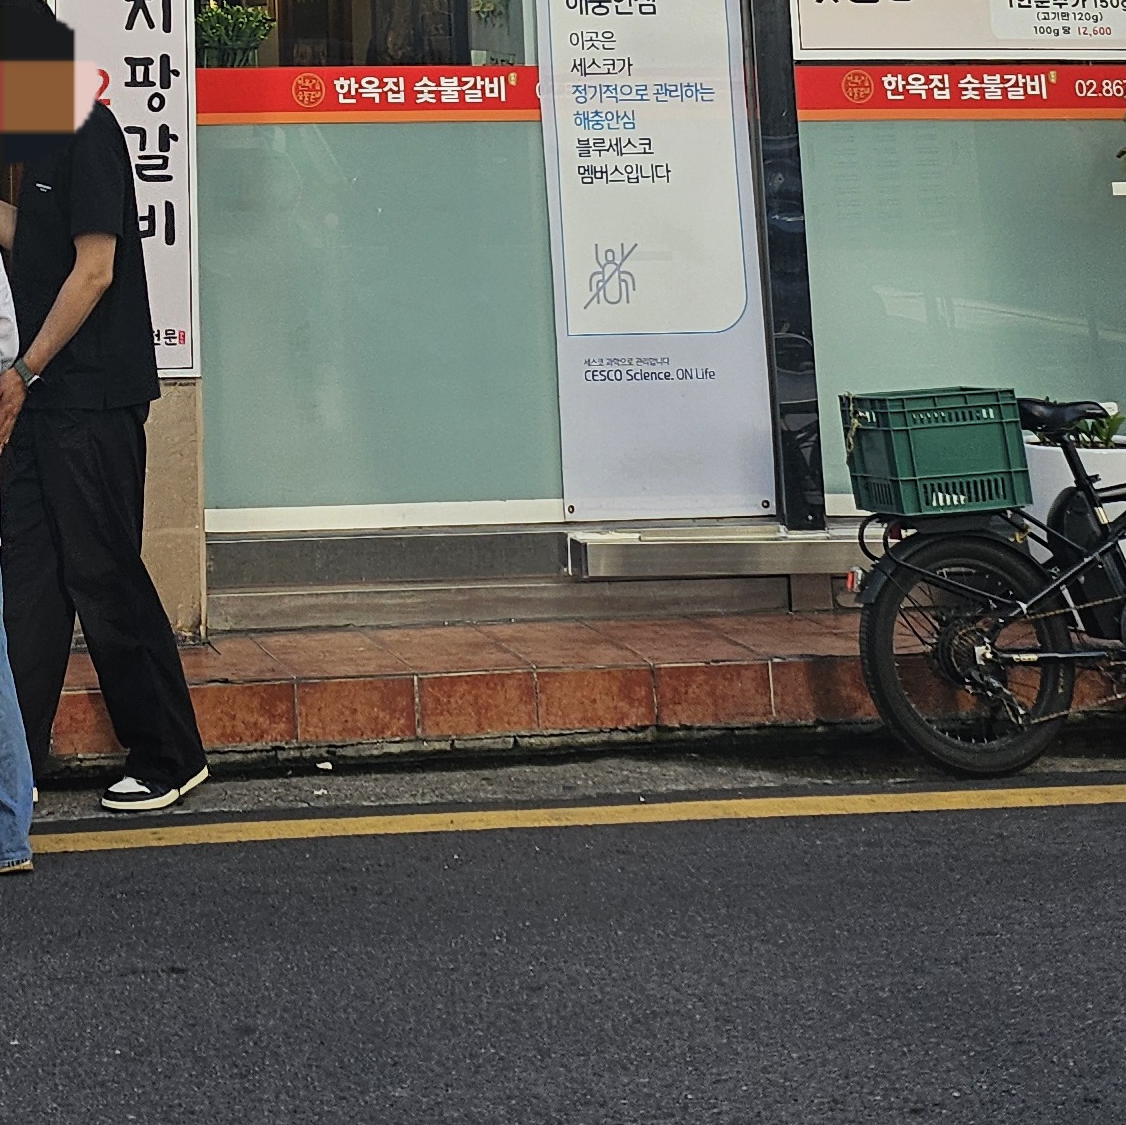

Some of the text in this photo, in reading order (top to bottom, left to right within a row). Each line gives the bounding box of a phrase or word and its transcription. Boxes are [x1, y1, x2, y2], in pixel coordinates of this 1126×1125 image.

[569, 31, 617, 51] 이곳은
[1034, 26, 1060, 36] 100g
[1077, 26, 1112, 37] 12,600
[570, 57, 633, 77] 세스코가
[334, 76, 405, 103] 한옥집
[414, 75, 506, 103] 숯불갈비
[572, 82, 715, 104] 정기적으로 관리하는
[881, 73, 950, 100] 한옥집
[958, 73, 1048, 100] 숯불갈비
[1075, 79, 1126, 97] 02.86
[573, 109, 636, 131] 해충안심
[576, 136, 654, 157] 블루세스코
[577, 163, 671, 184] 멤버스입니다
[584, 367, 716, 382] CESCO Science. ON Life
